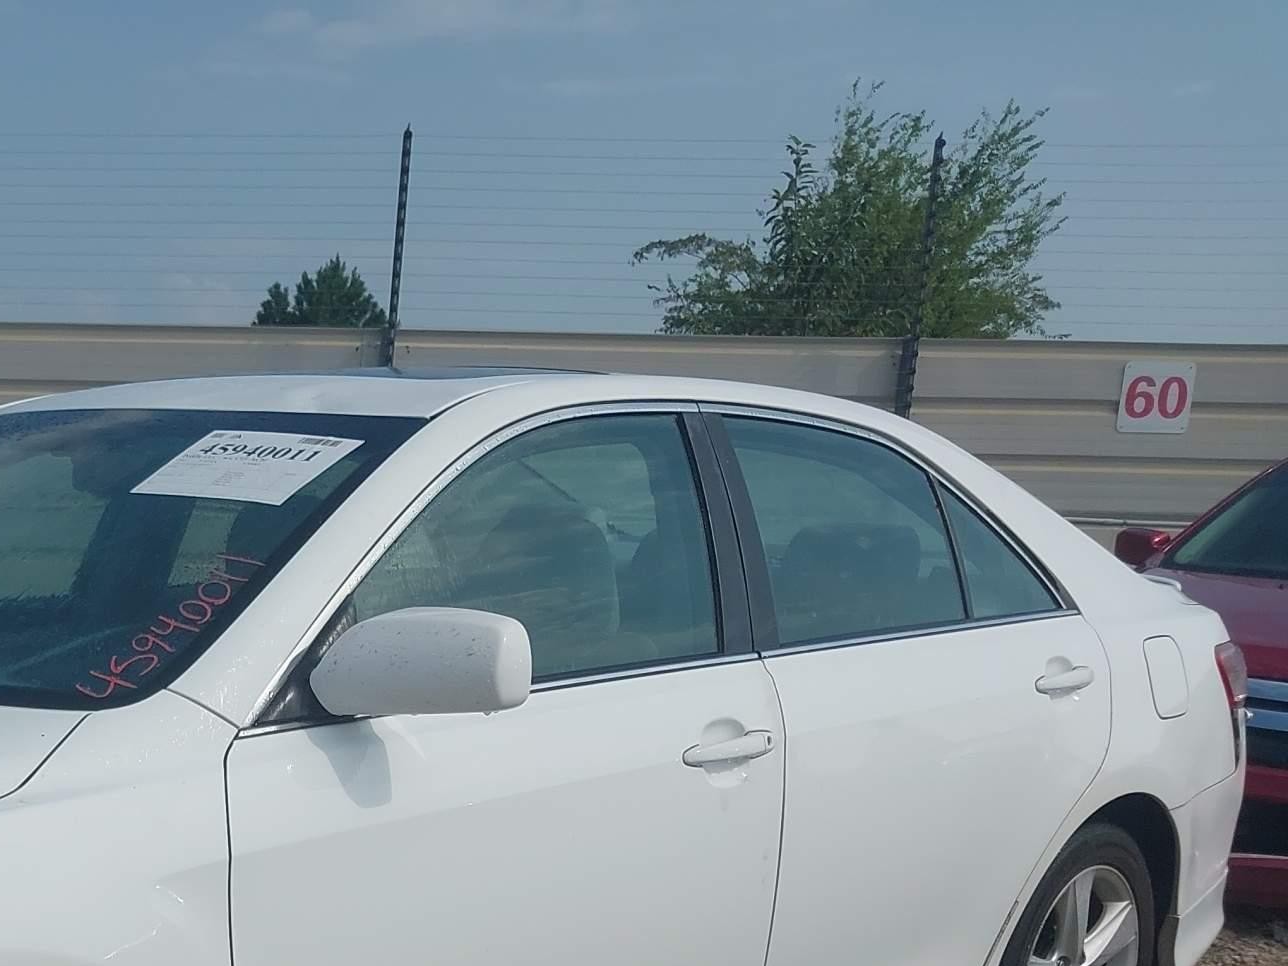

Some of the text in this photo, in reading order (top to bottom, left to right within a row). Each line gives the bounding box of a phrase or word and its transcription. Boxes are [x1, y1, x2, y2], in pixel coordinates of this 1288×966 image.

[1124, 375, 1188, 419] 60
[199, 442, 323, 463] 45940011
[75, 554, 267, 698] 45940011
